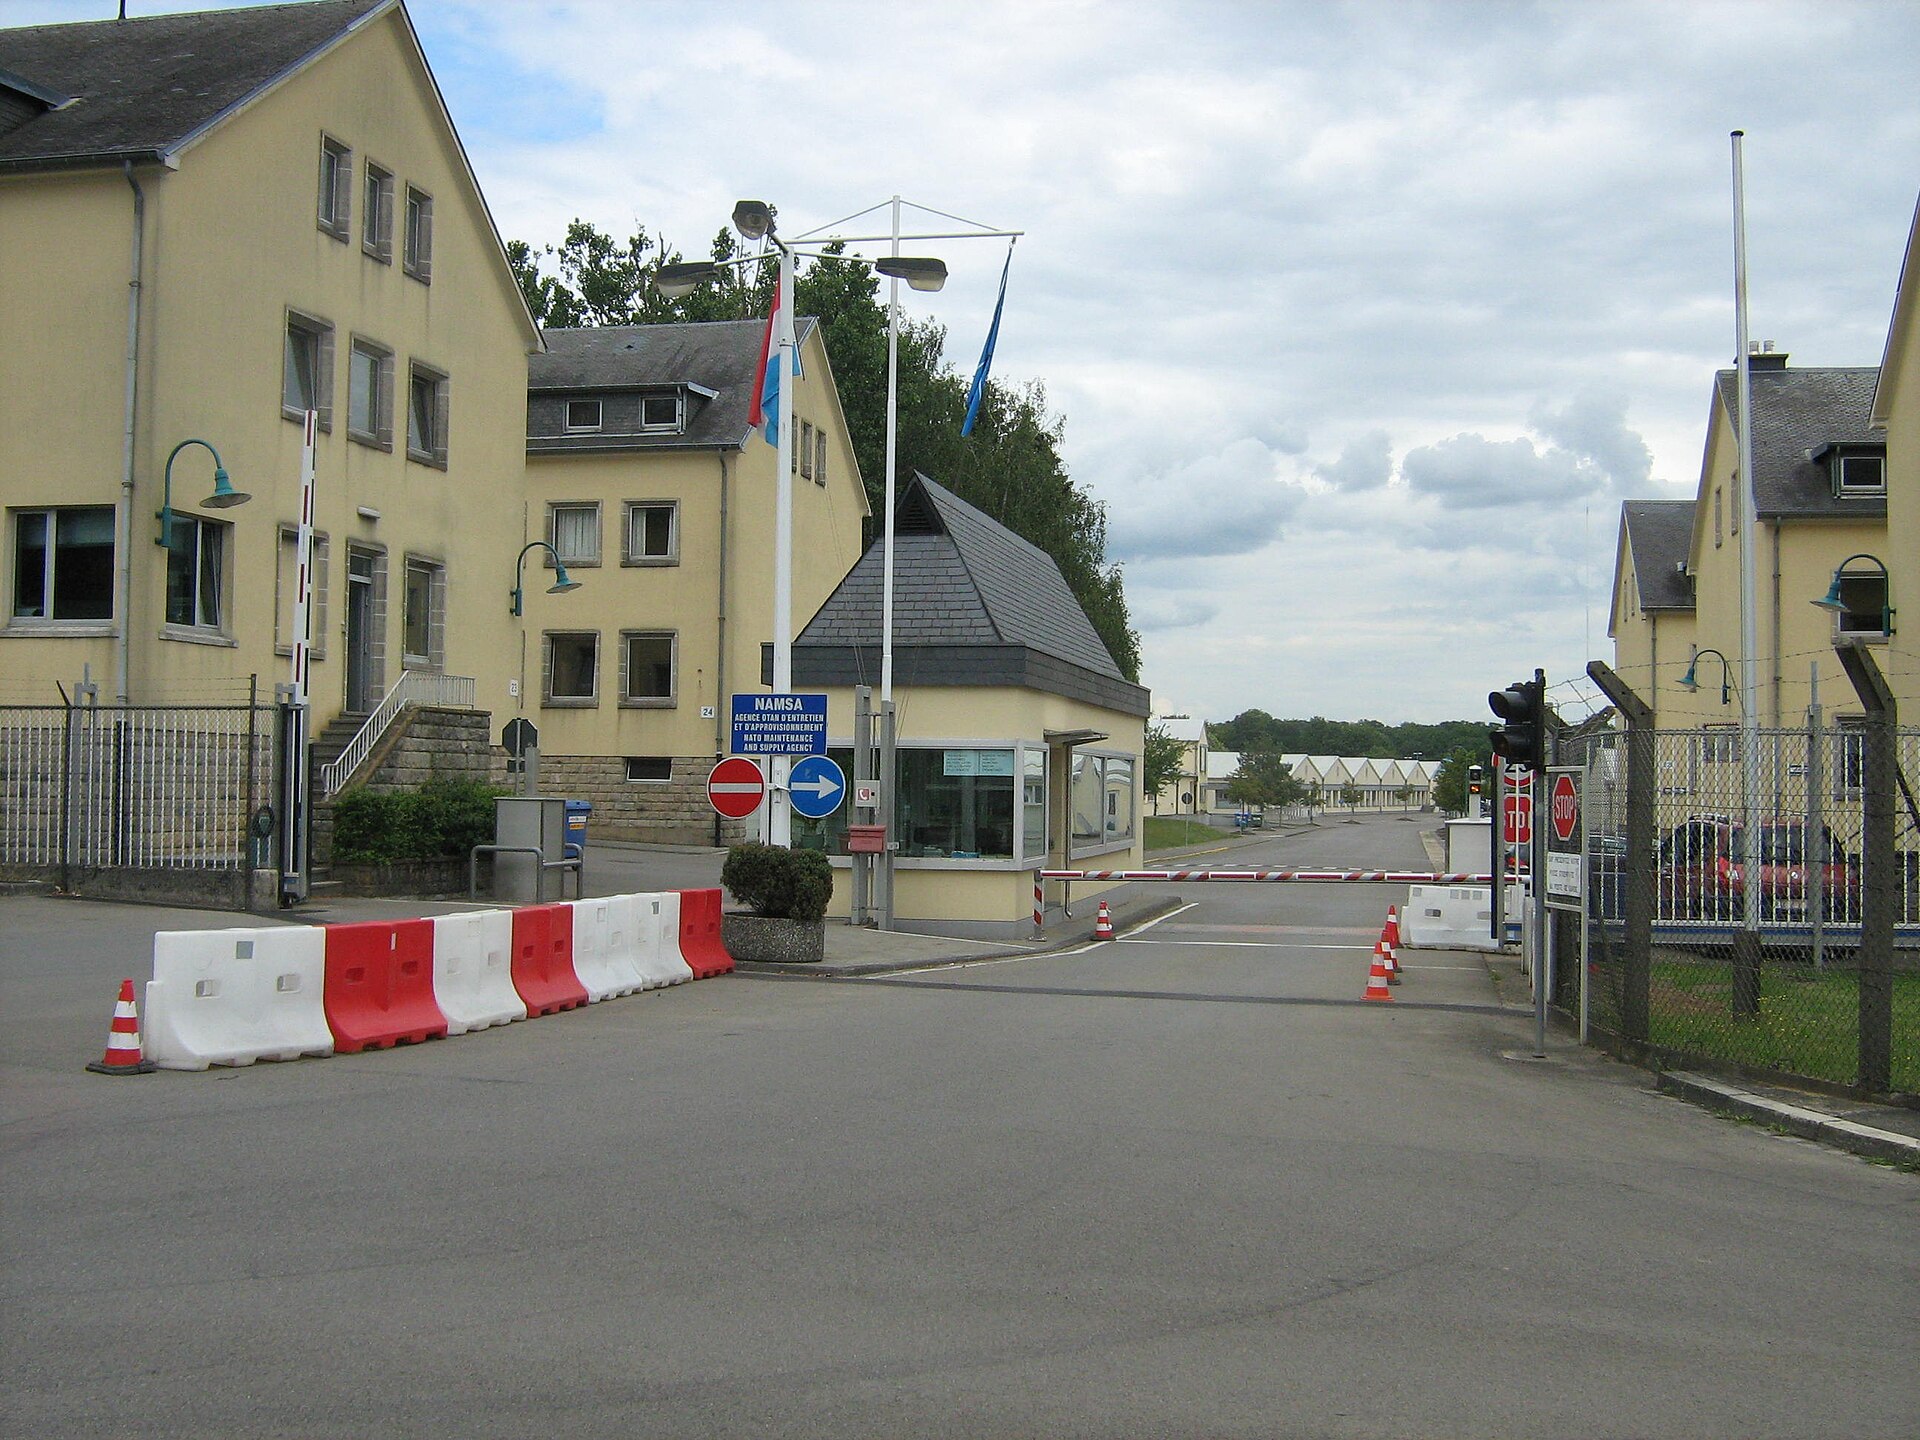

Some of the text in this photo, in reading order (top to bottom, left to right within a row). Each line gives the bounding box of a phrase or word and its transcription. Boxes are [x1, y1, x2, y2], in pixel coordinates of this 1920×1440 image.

[755, 697, 803, 711] NAMSA
[703, 708, 713, 716] 24
[734, 713, 824, 722] AGENCE OTAN D'ENTRETIEN
[734, 723, 824, 732] ET D'APPROVISIONNEMENT
[743, 734, 813, 743] NATO MAINTENANCE
[743, 743, 813, 752] AND SUPPLY AGENCY
[1555, 795, 1574, 820] STOP
